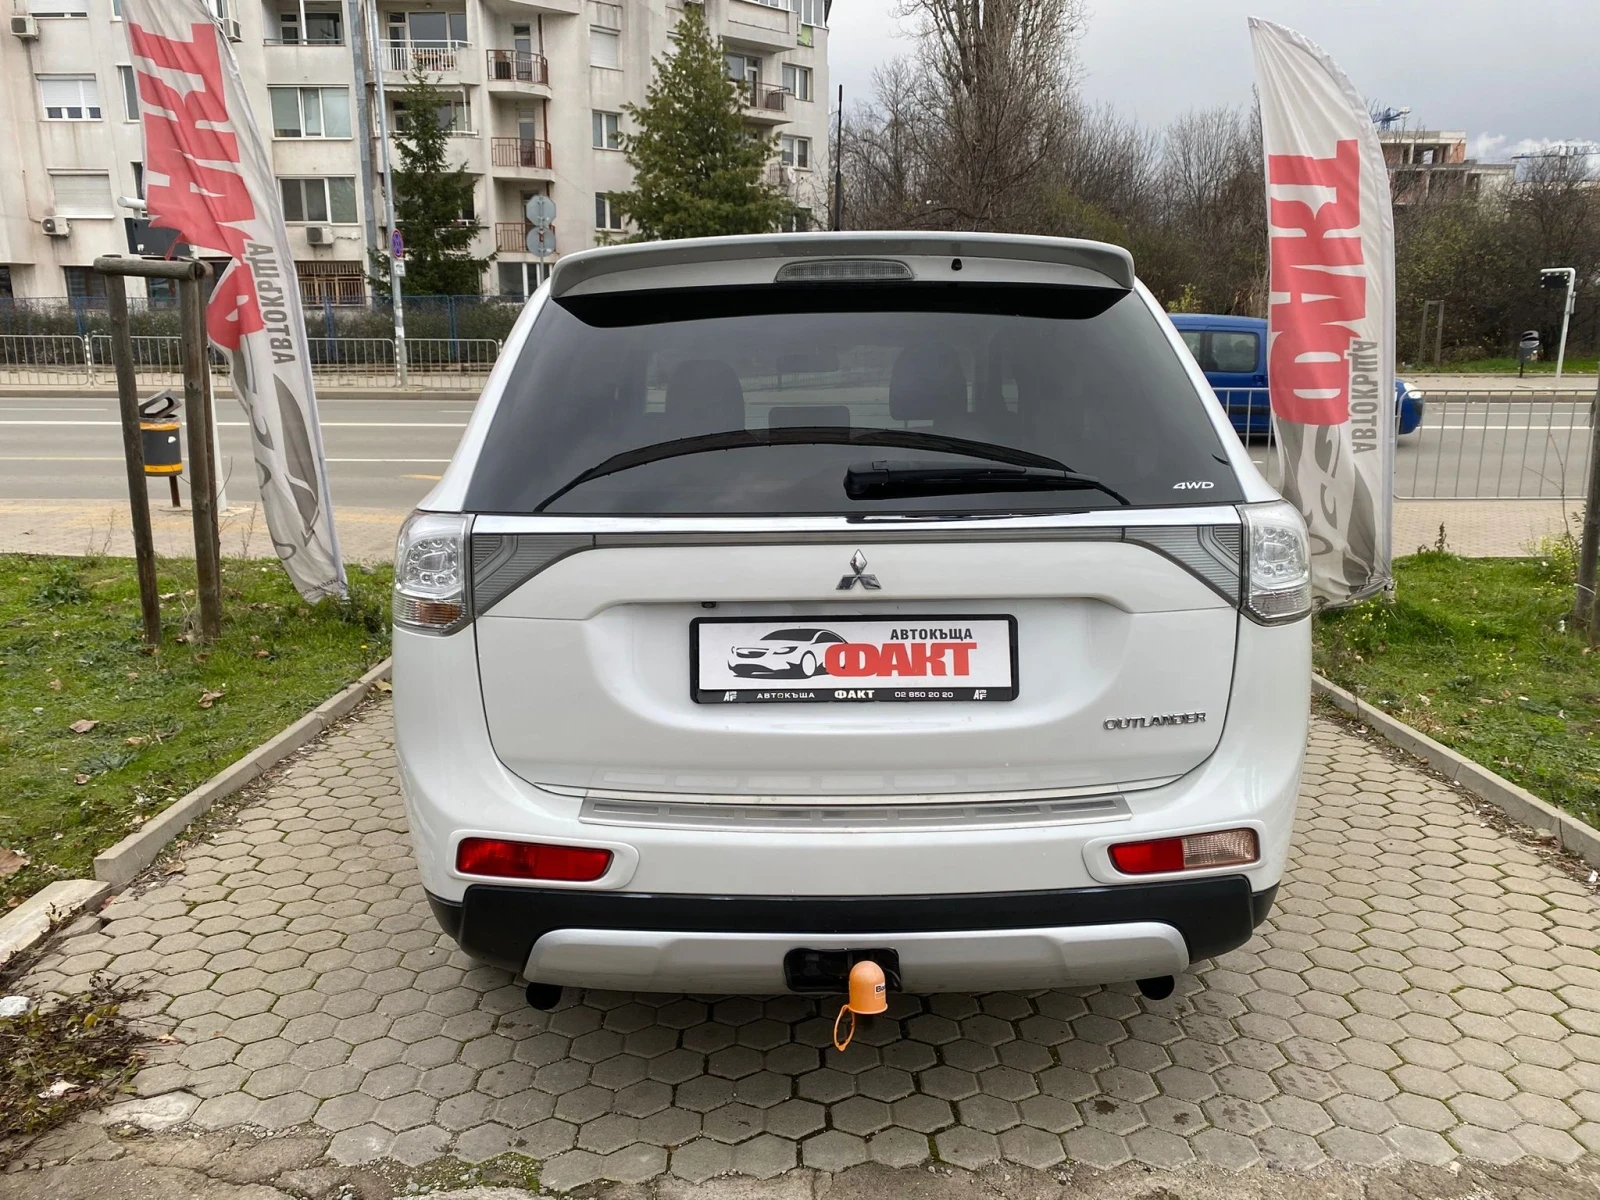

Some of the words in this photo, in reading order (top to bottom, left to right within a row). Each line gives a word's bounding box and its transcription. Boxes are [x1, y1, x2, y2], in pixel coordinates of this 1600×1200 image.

[1172, 481, 1215, 490] 4WD
[890, 628, 973, 641] АВТОКЪЩА
[824, 642, 978, 677] ФАКТ
[834, 690, 875, 699] ФАКТ
[1103, 711, 1206, 731] OUTLANDER
